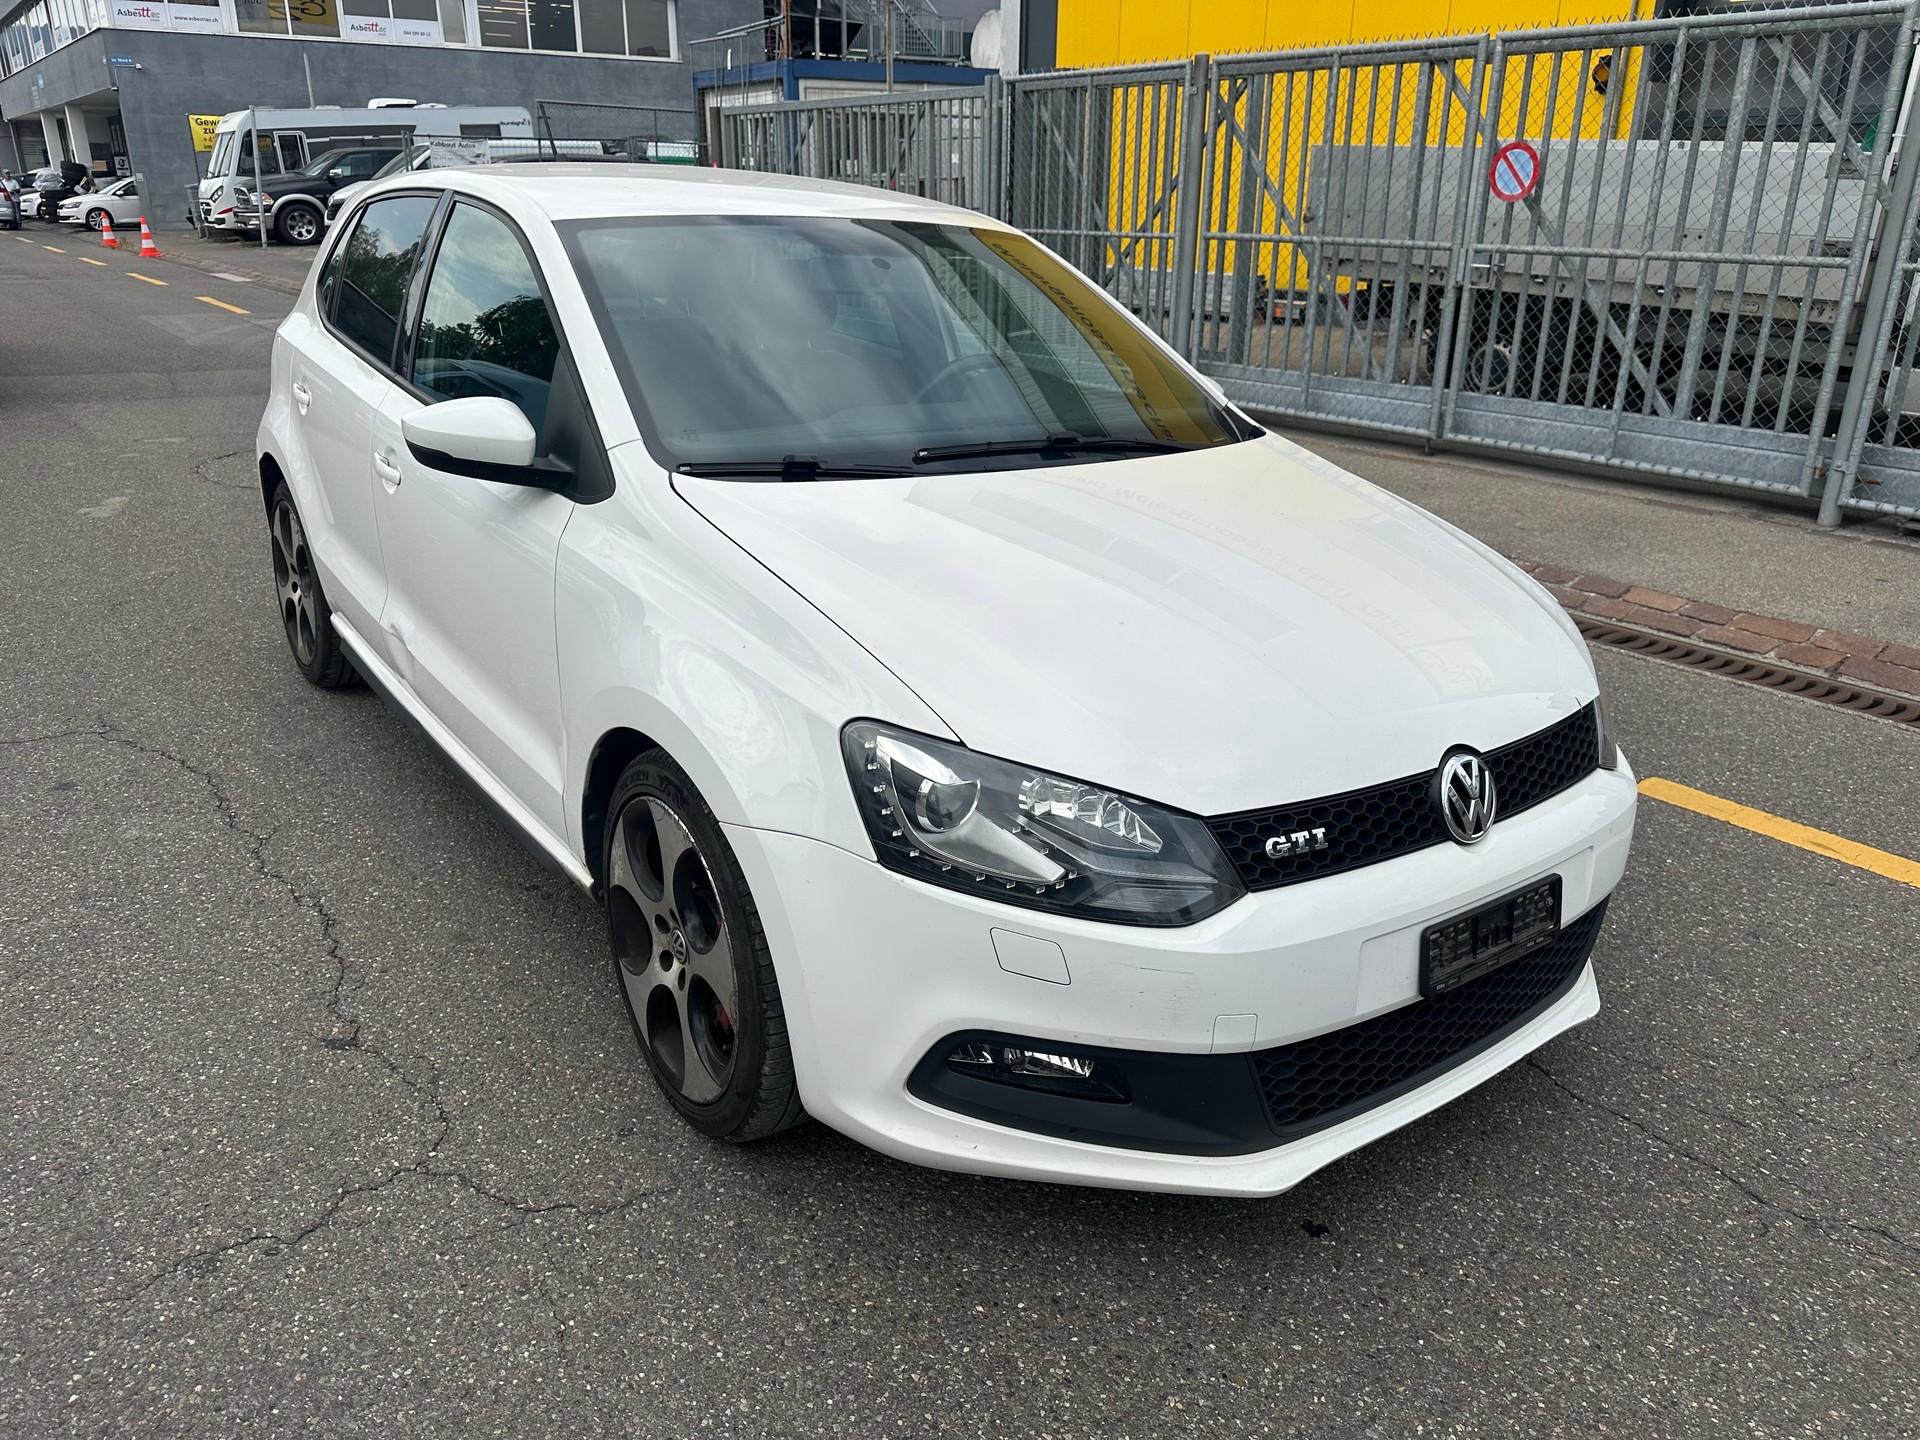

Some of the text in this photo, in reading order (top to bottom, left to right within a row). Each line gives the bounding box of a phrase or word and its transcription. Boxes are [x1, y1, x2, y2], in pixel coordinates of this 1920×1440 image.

[117, 7, 160, 19] Asbesttec
[174, 15, 219, 23] www.asbesttec.ch
[350, 22, 387, 33] Asbesttec
[1265, 827, 1329, 860] GTI
